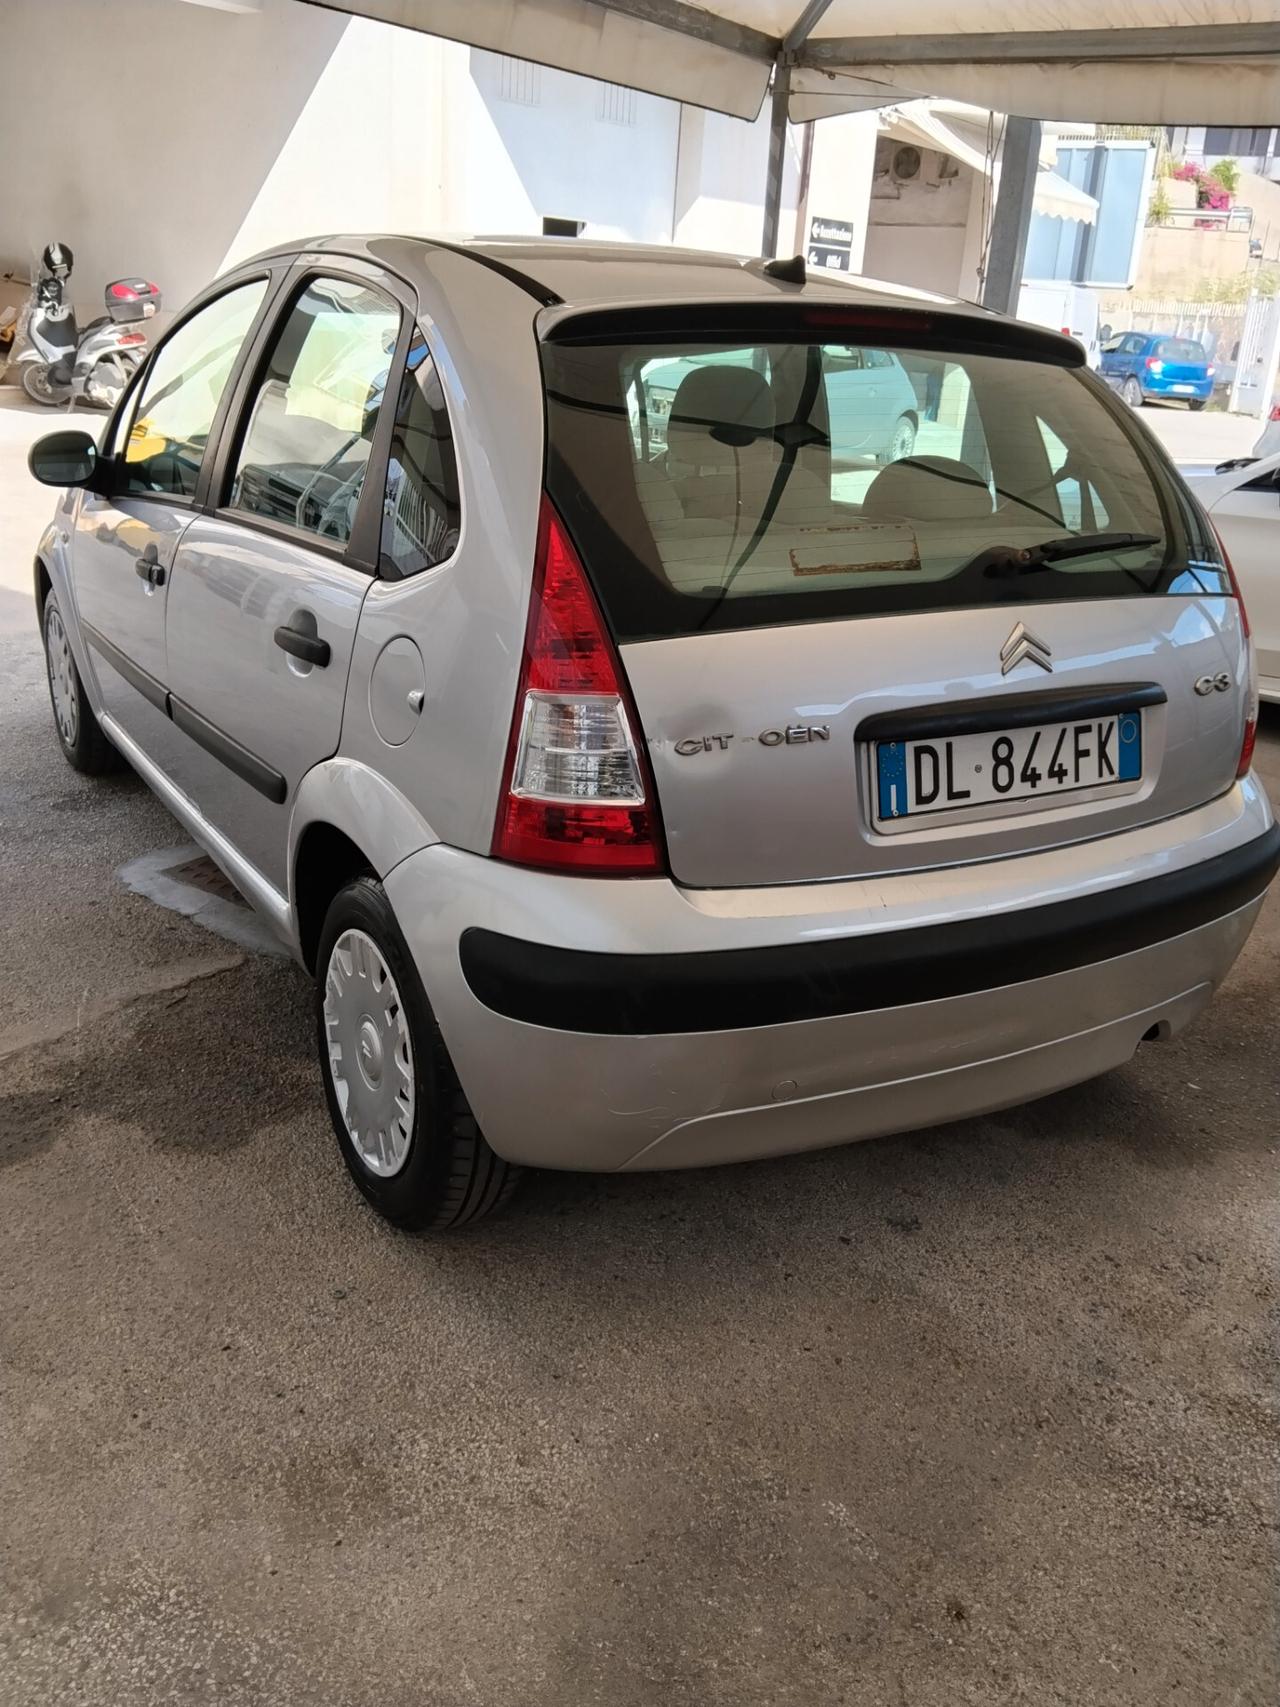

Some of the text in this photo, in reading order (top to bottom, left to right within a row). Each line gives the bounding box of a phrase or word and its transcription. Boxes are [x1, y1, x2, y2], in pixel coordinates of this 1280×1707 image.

[1193, 672, 1231, 696] C3
[913, 721, 1115, 806] DL 844FK
